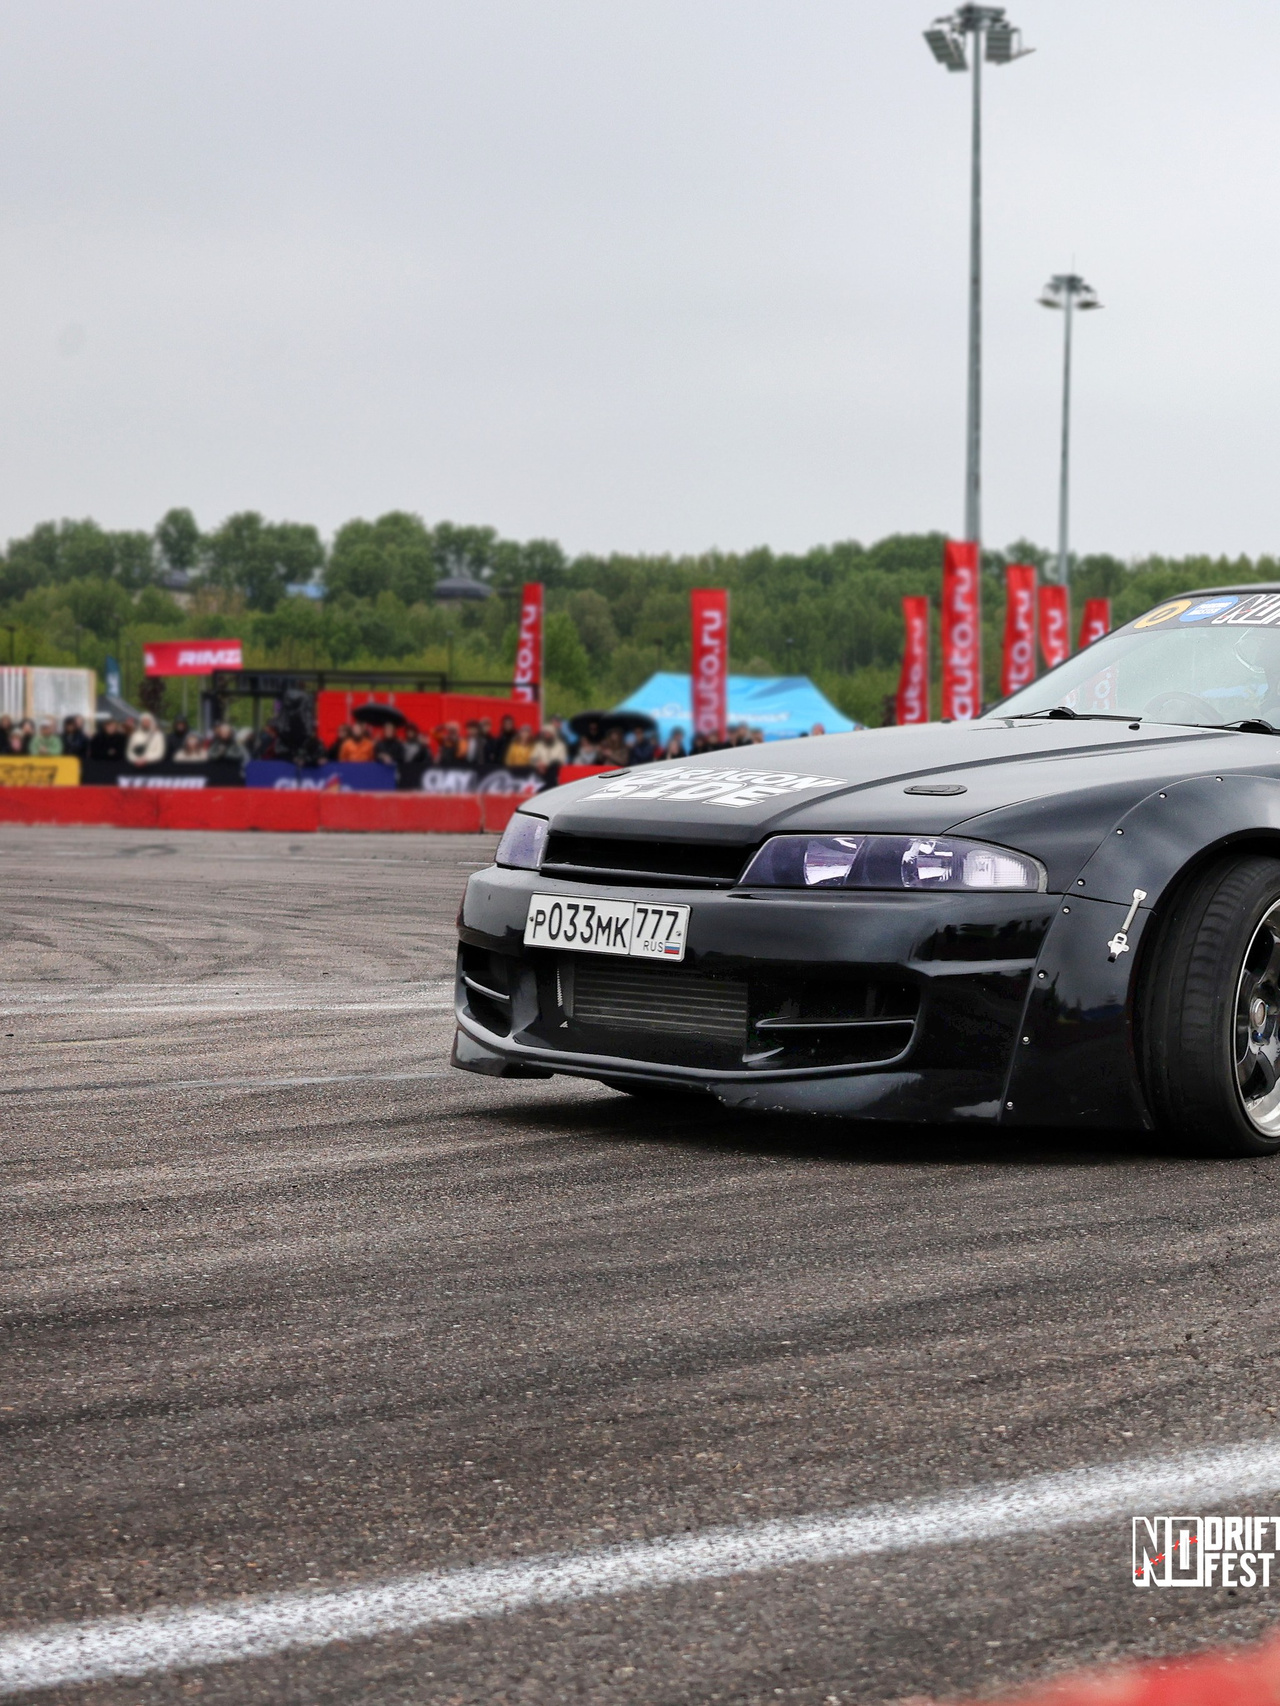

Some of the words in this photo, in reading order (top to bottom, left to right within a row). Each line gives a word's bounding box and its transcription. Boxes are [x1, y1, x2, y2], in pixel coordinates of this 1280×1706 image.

[515, 605, 537, 703] uto.ru
[952, 567, 974, 721] auto.ru
[577, 780, 784, 808] SIDE
[636, 908, 680, 941] 777
[643, 940, 664, 952] RUS
